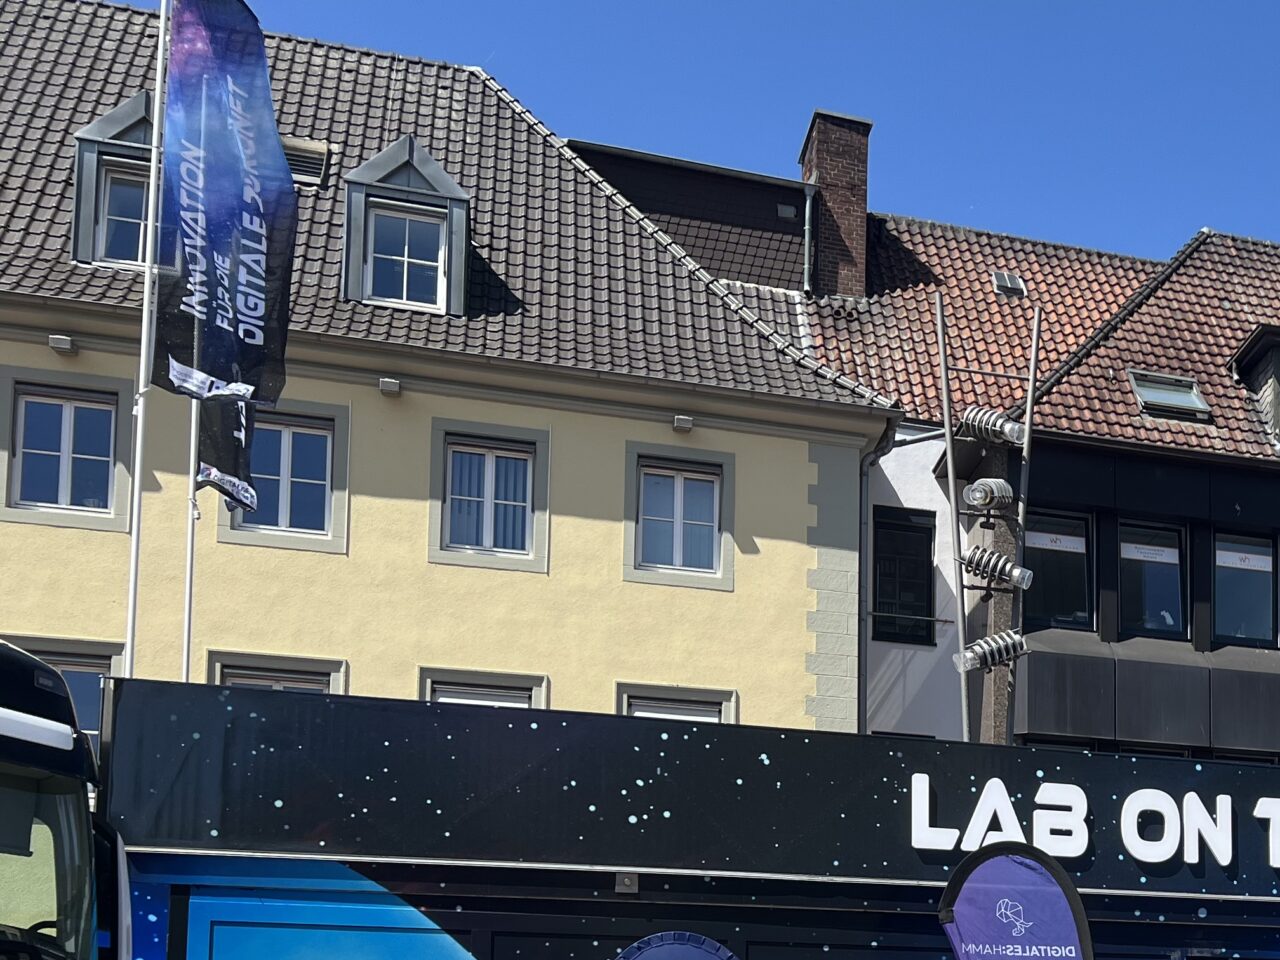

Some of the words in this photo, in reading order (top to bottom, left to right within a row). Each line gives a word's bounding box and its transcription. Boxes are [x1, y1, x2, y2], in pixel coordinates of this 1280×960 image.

[180, 139, 208, 320] INNOVATION
[213, 251, 231, 288] DIE
[212, 286, 234, 332] FÜR
[236, 211, 267, 346] DIGITALE
[911, 773, 1089, 858] LAB
[1120, 788, 1232, 867] ON
